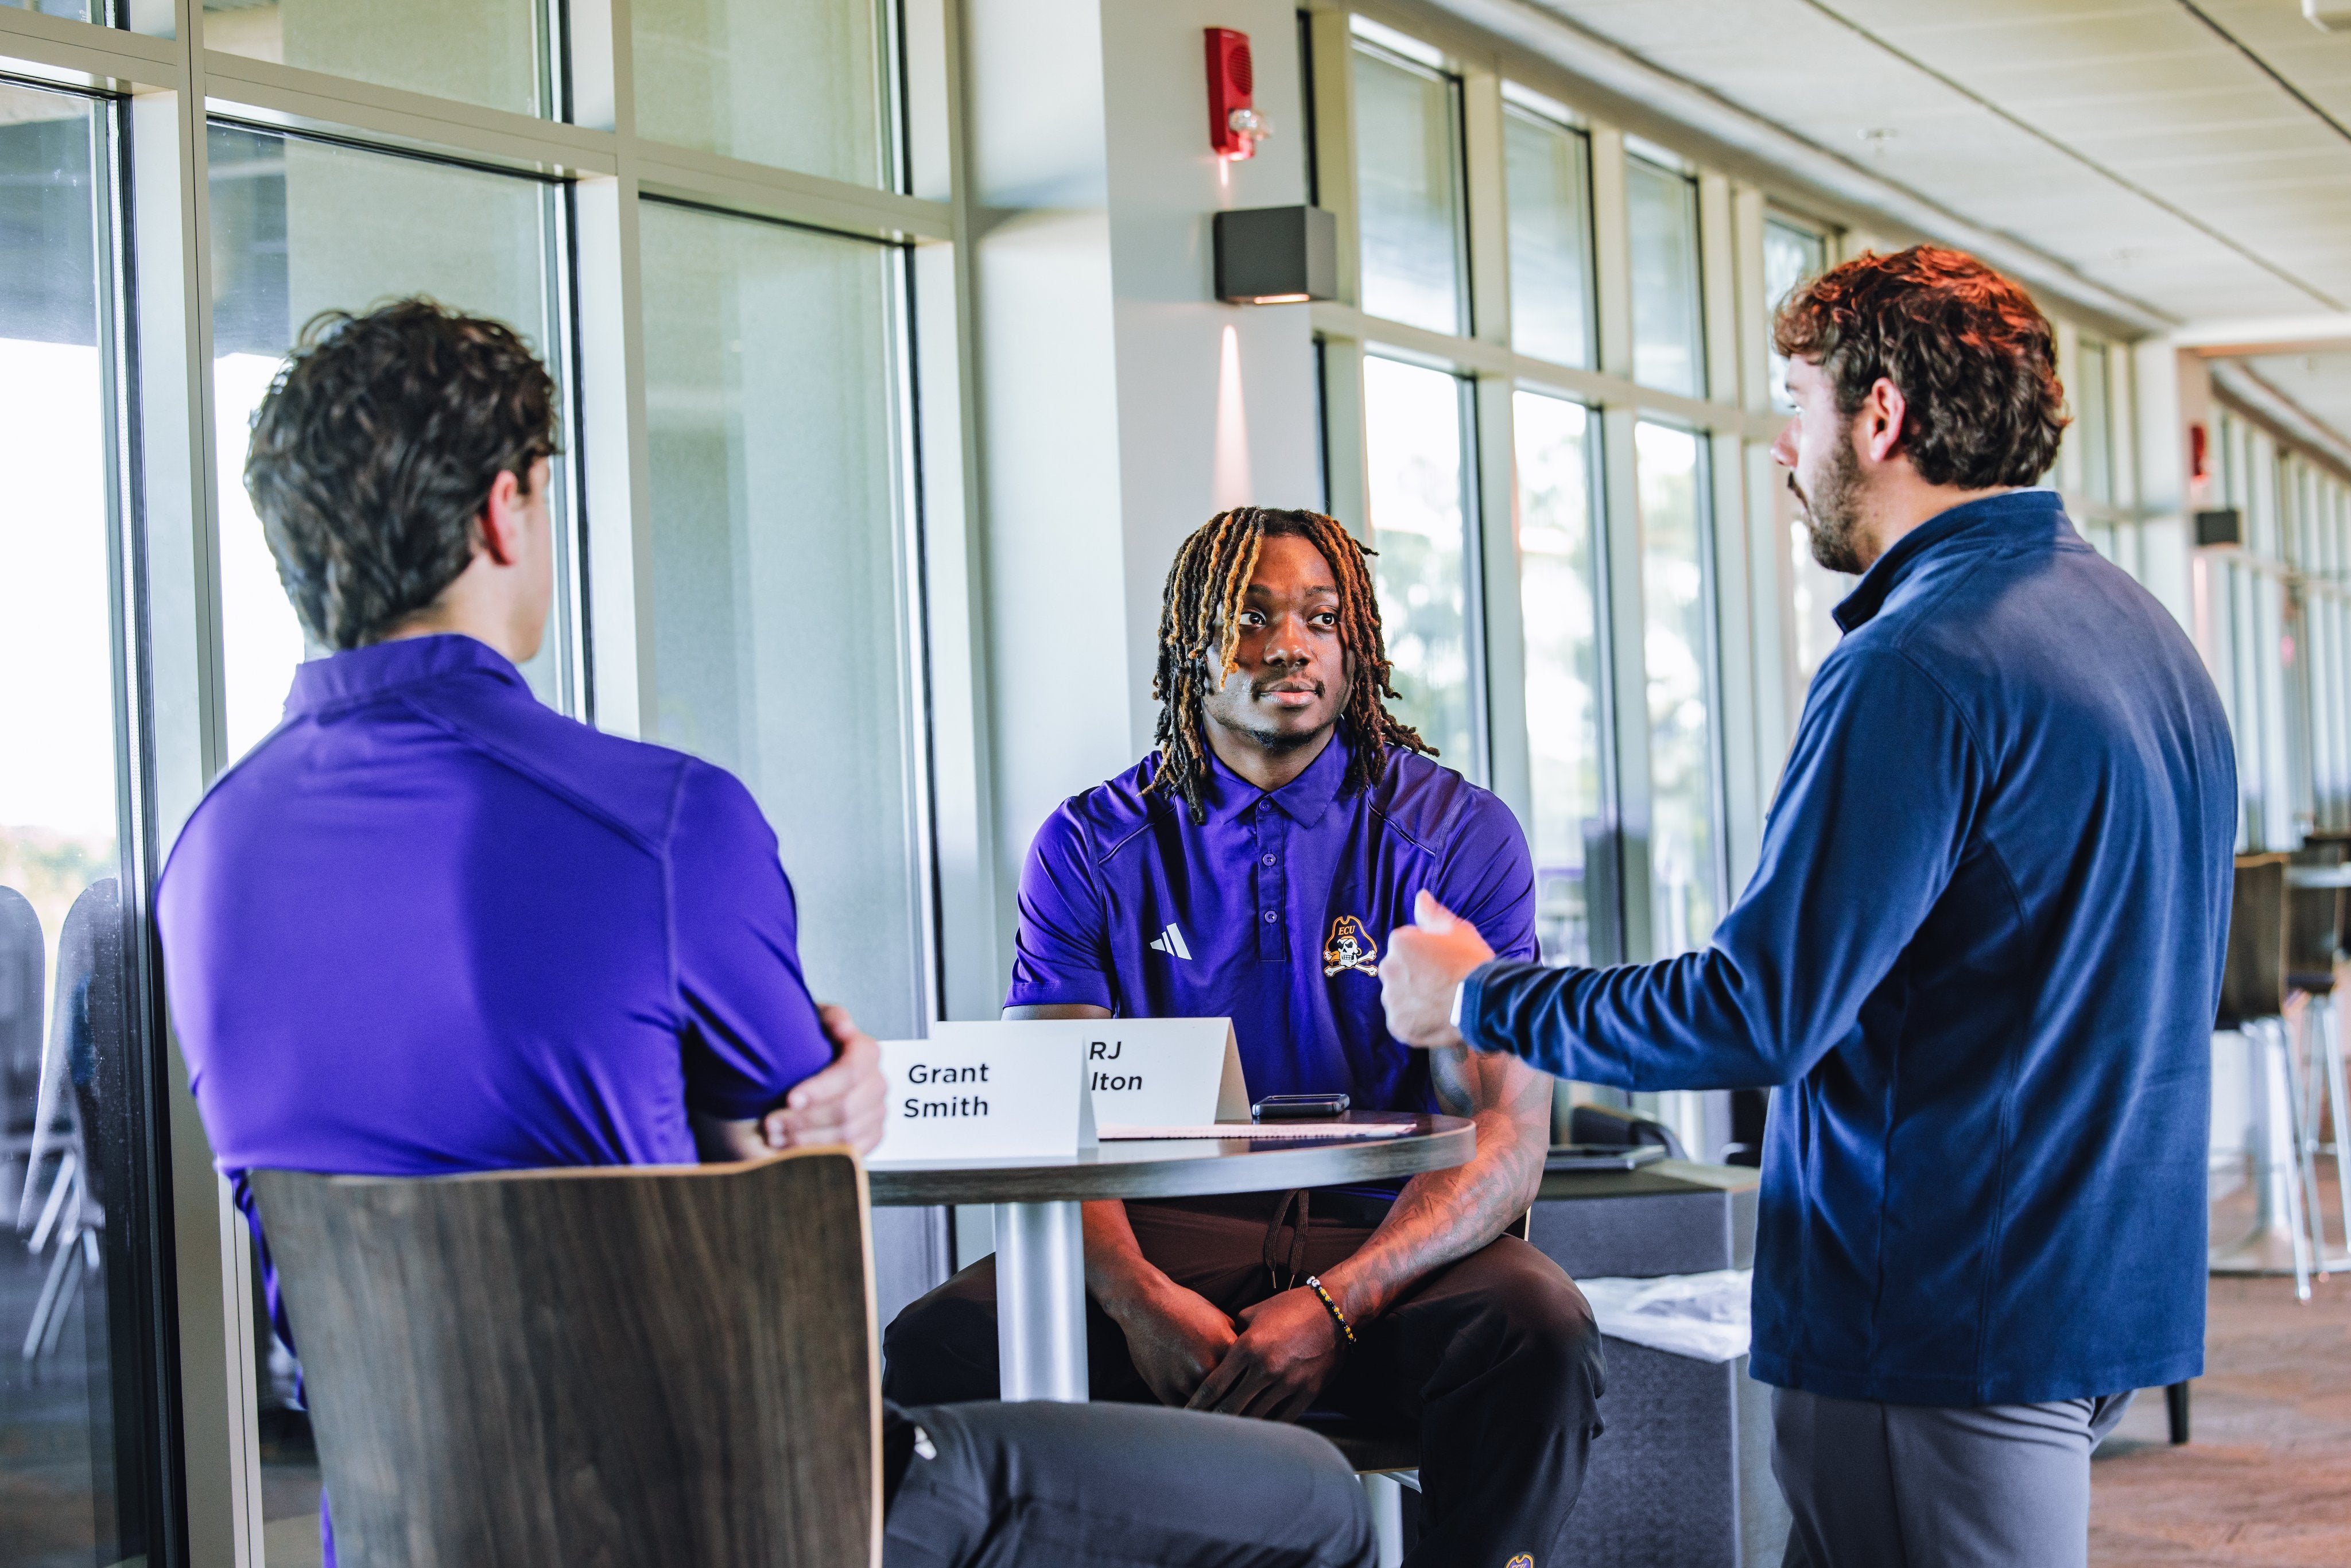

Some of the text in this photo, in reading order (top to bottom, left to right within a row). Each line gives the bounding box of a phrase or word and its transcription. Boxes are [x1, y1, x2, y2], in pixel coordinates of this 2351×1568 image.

[1338, 925, 1356, 936] ECU
[1089, 1041, 1122, 1059] RJ
[909, 1064, 989, 1084] Grant
[1091, 1072, 1142, 1090] lton
[904, 1096, 988, 1117] Smith
